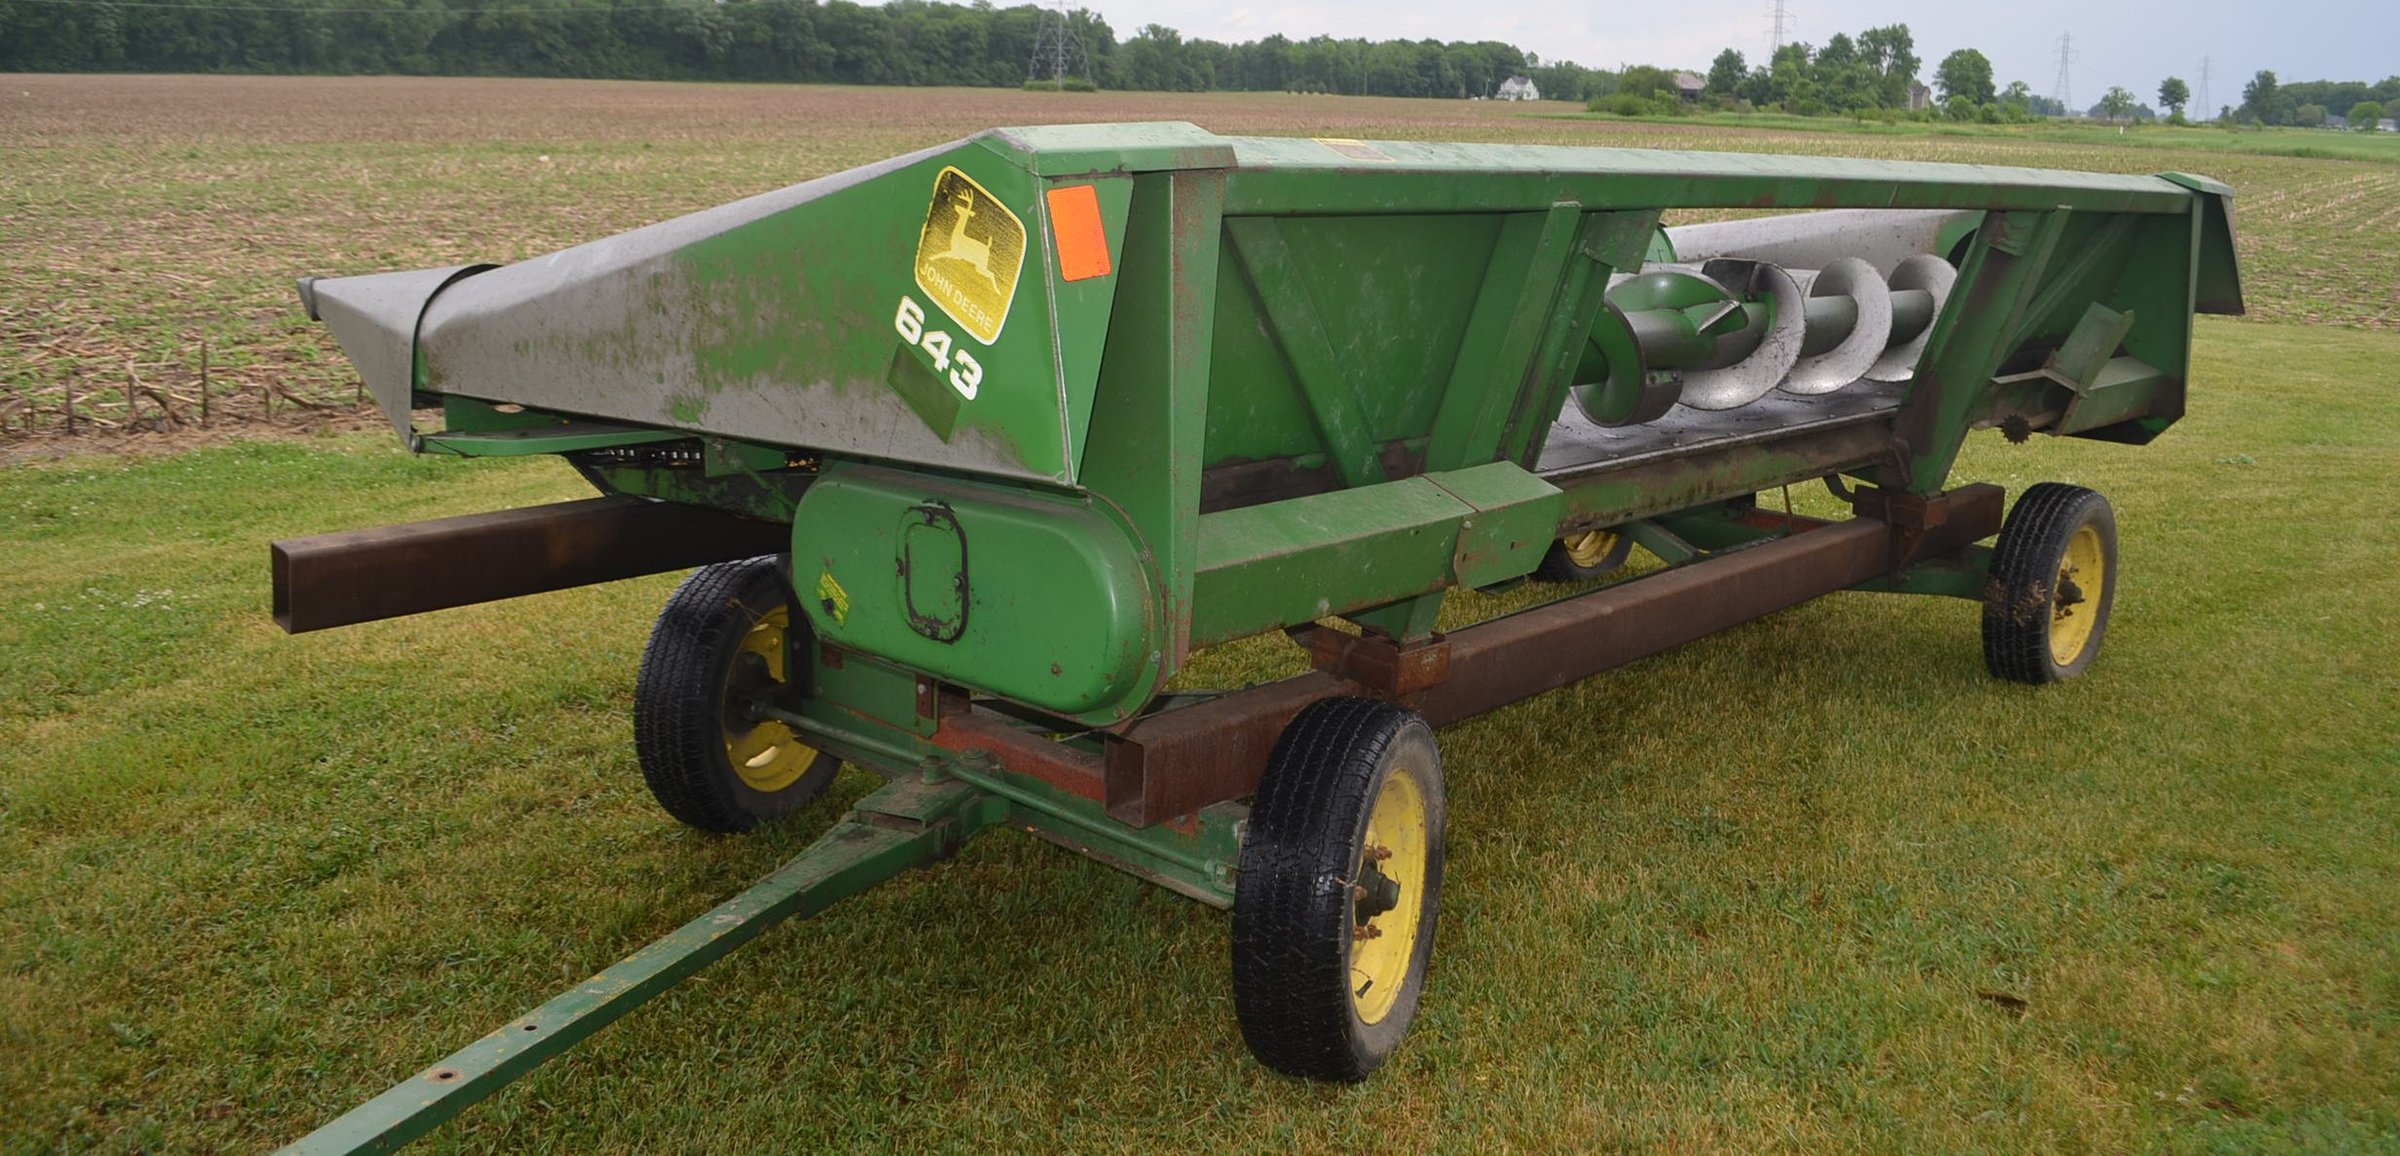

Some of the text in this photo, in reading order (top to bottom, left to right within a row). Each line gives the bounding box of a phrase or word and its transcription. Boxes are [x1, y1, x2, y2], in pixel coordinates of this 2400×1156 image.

[920, 265, 994, 333] JOHN DEERE
[895, 295, 983, 401] 643
